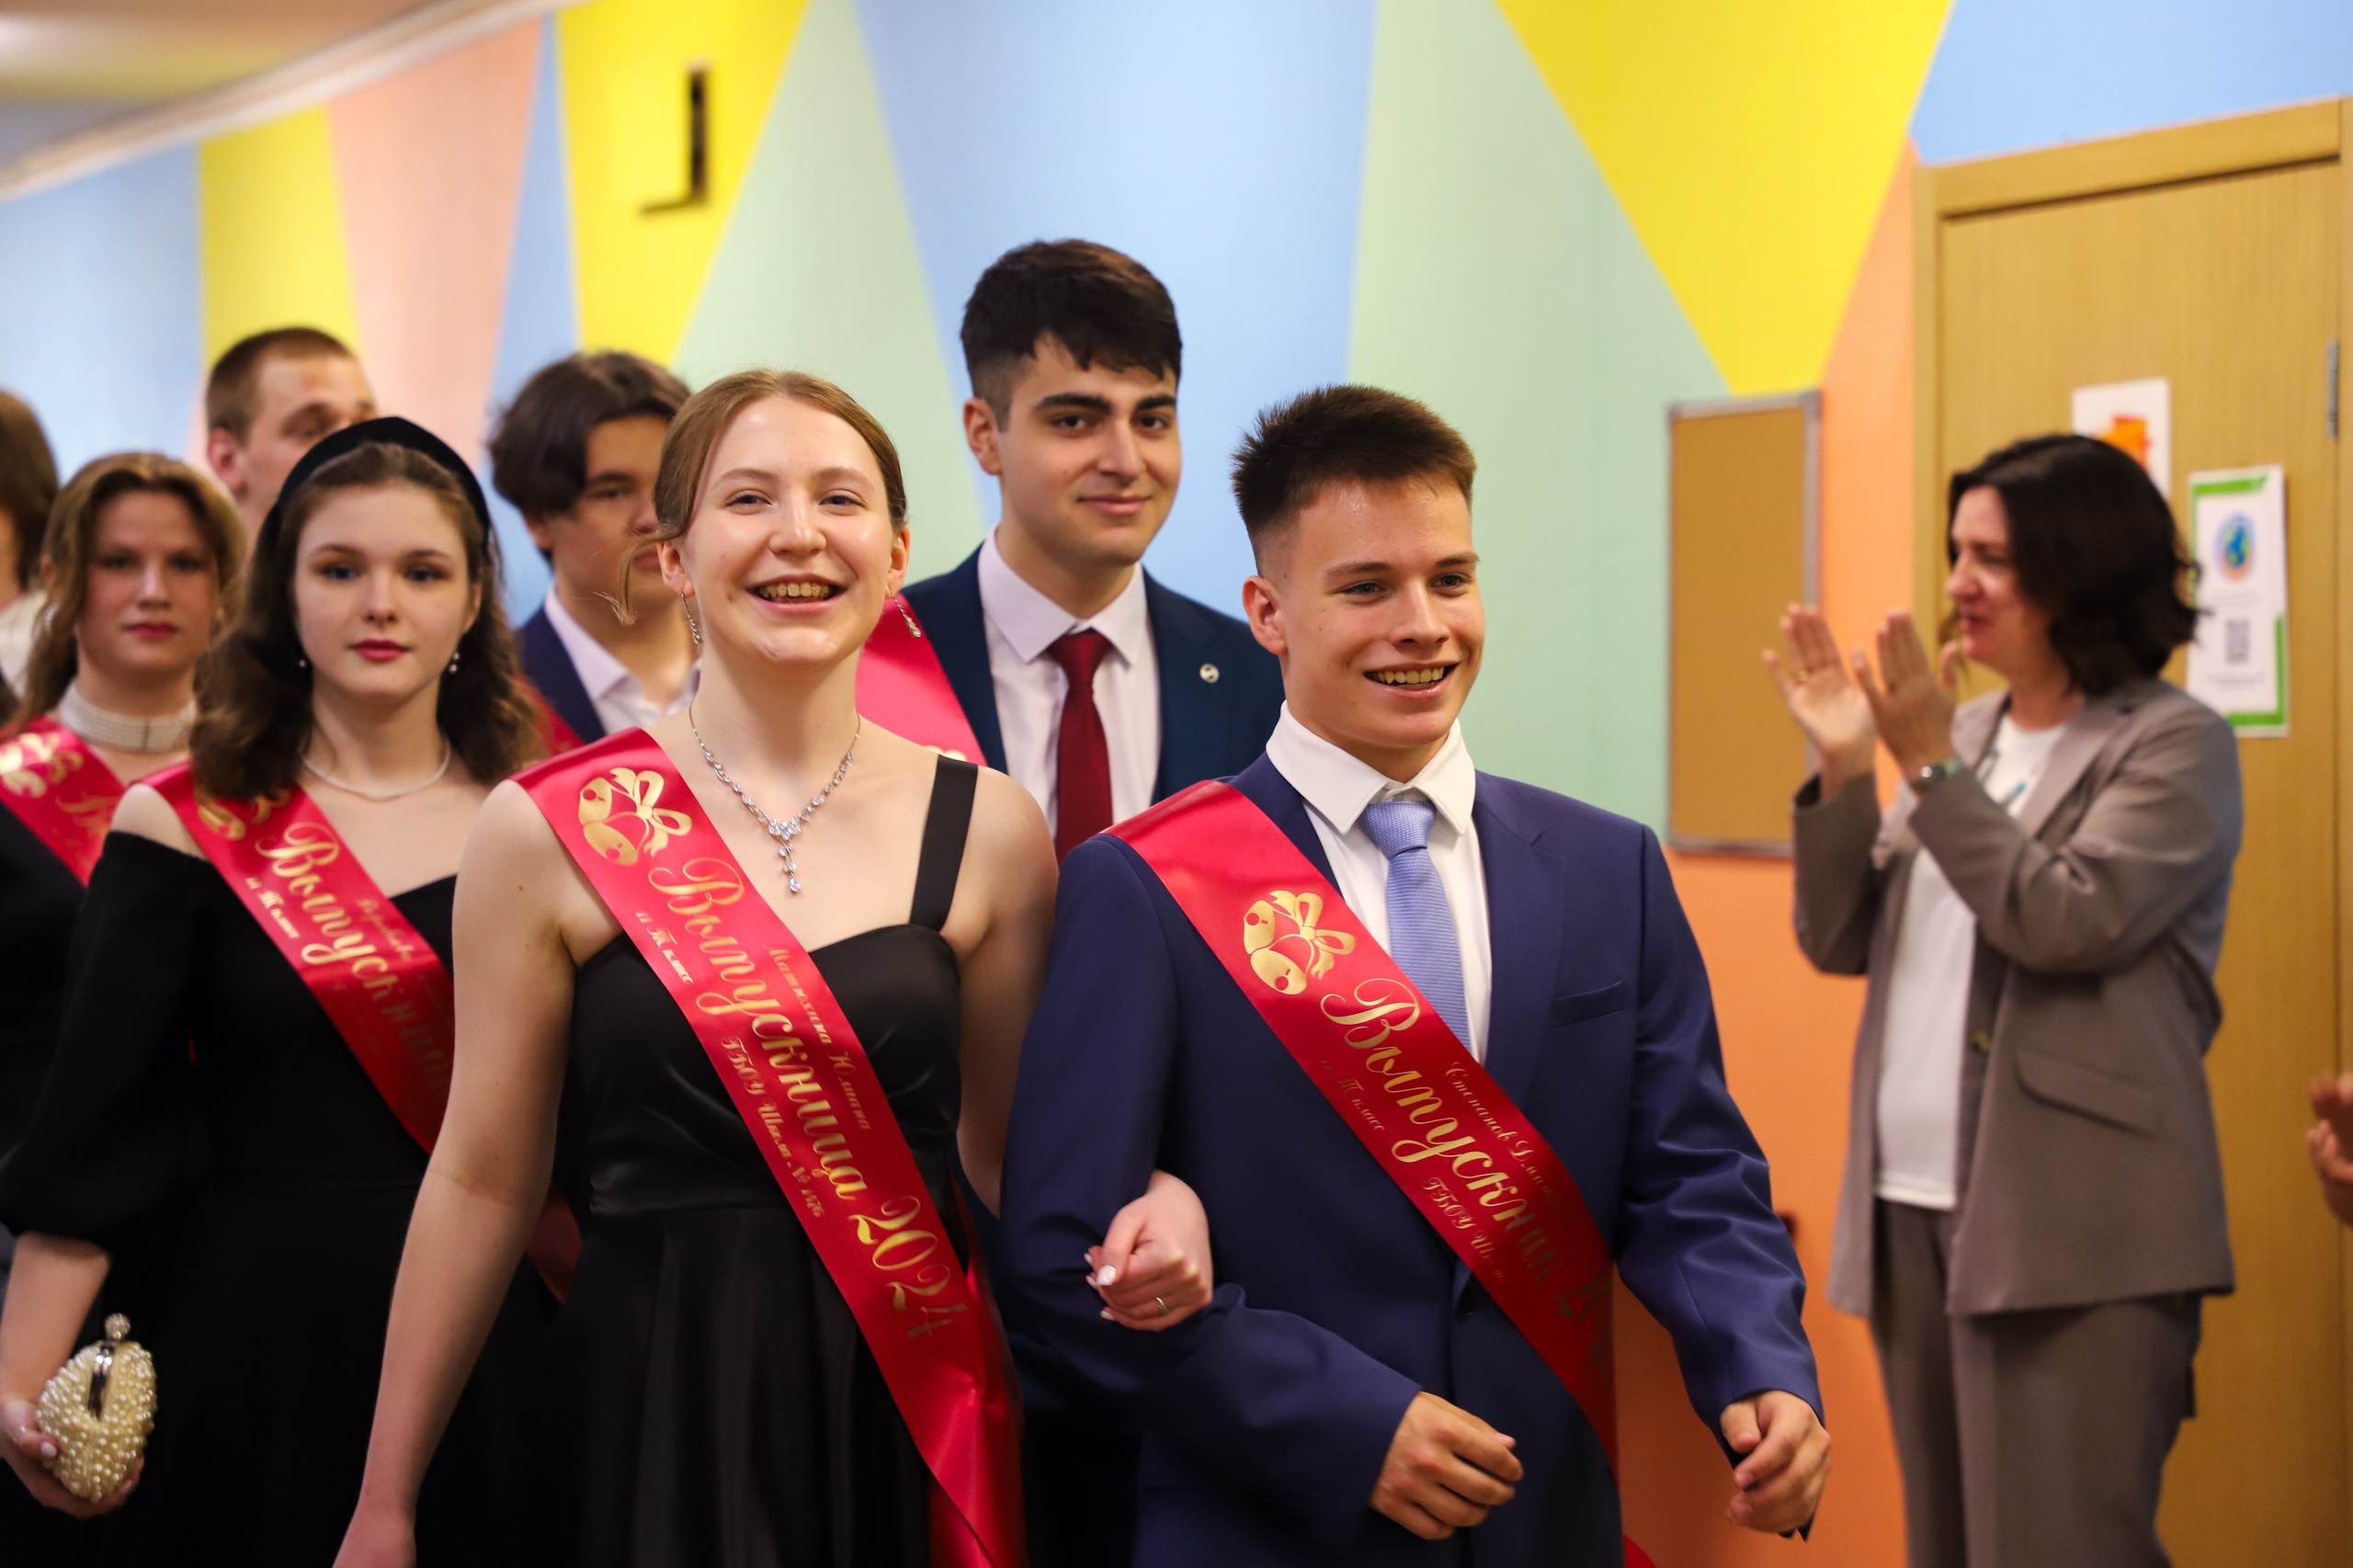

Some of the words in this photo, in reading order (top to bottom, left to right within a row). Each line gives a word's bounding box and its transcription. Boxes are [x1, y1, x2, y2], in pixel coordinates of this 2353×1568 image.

[649, 858, 869, 1200] Выпускница
[847, 1195, 969, 1338] 2024
[721, 1035, 766, 1096] ГБОУ
[1445, 1061, 1516, 1142] Степанов
[1422, 1177, 1475, 1231] ГБОУ
